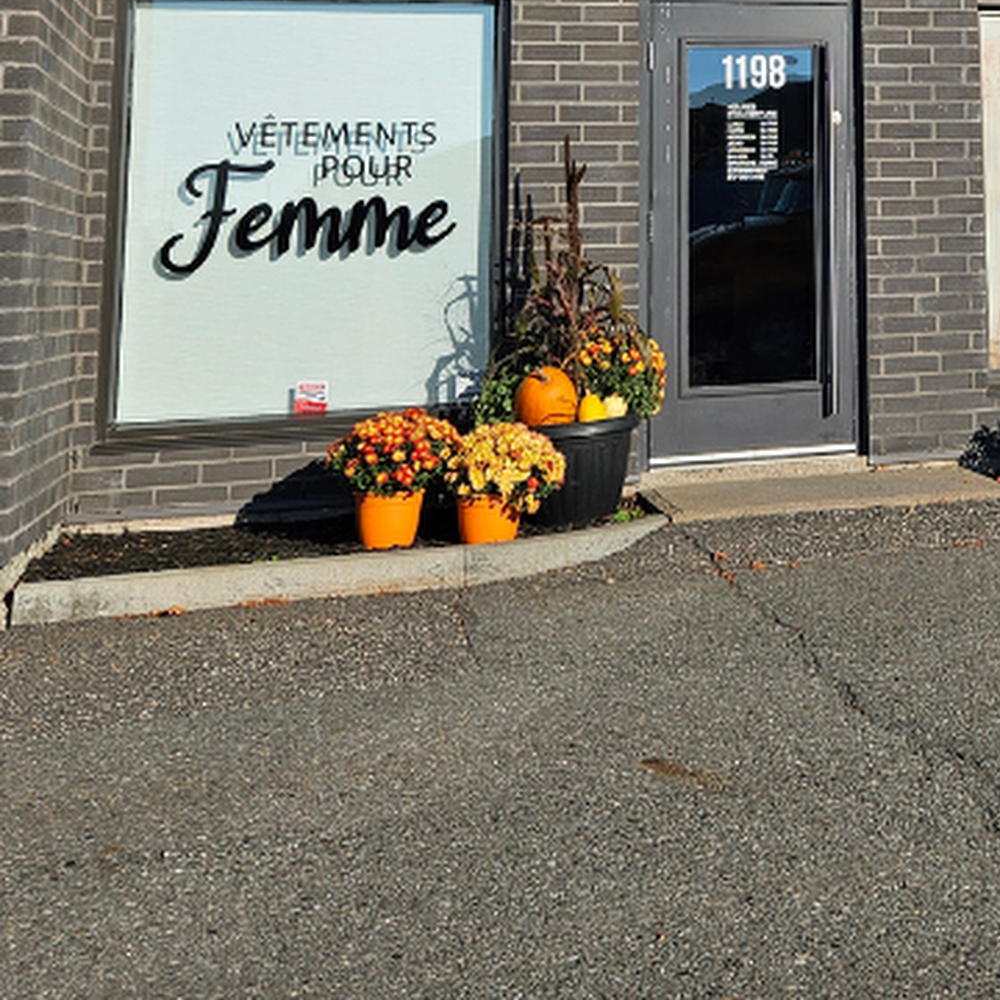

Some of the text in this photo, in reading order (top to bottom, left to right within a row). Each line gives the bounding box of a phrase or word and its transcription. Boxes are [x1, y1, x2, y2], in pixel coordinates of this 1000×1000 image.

[721, 54, 787, 90] 1198
[234, 113, 438, 148] VÊTEMENTS
[320, 154, 414, 180] POUR
[159, 158, 457, 275] Femme
